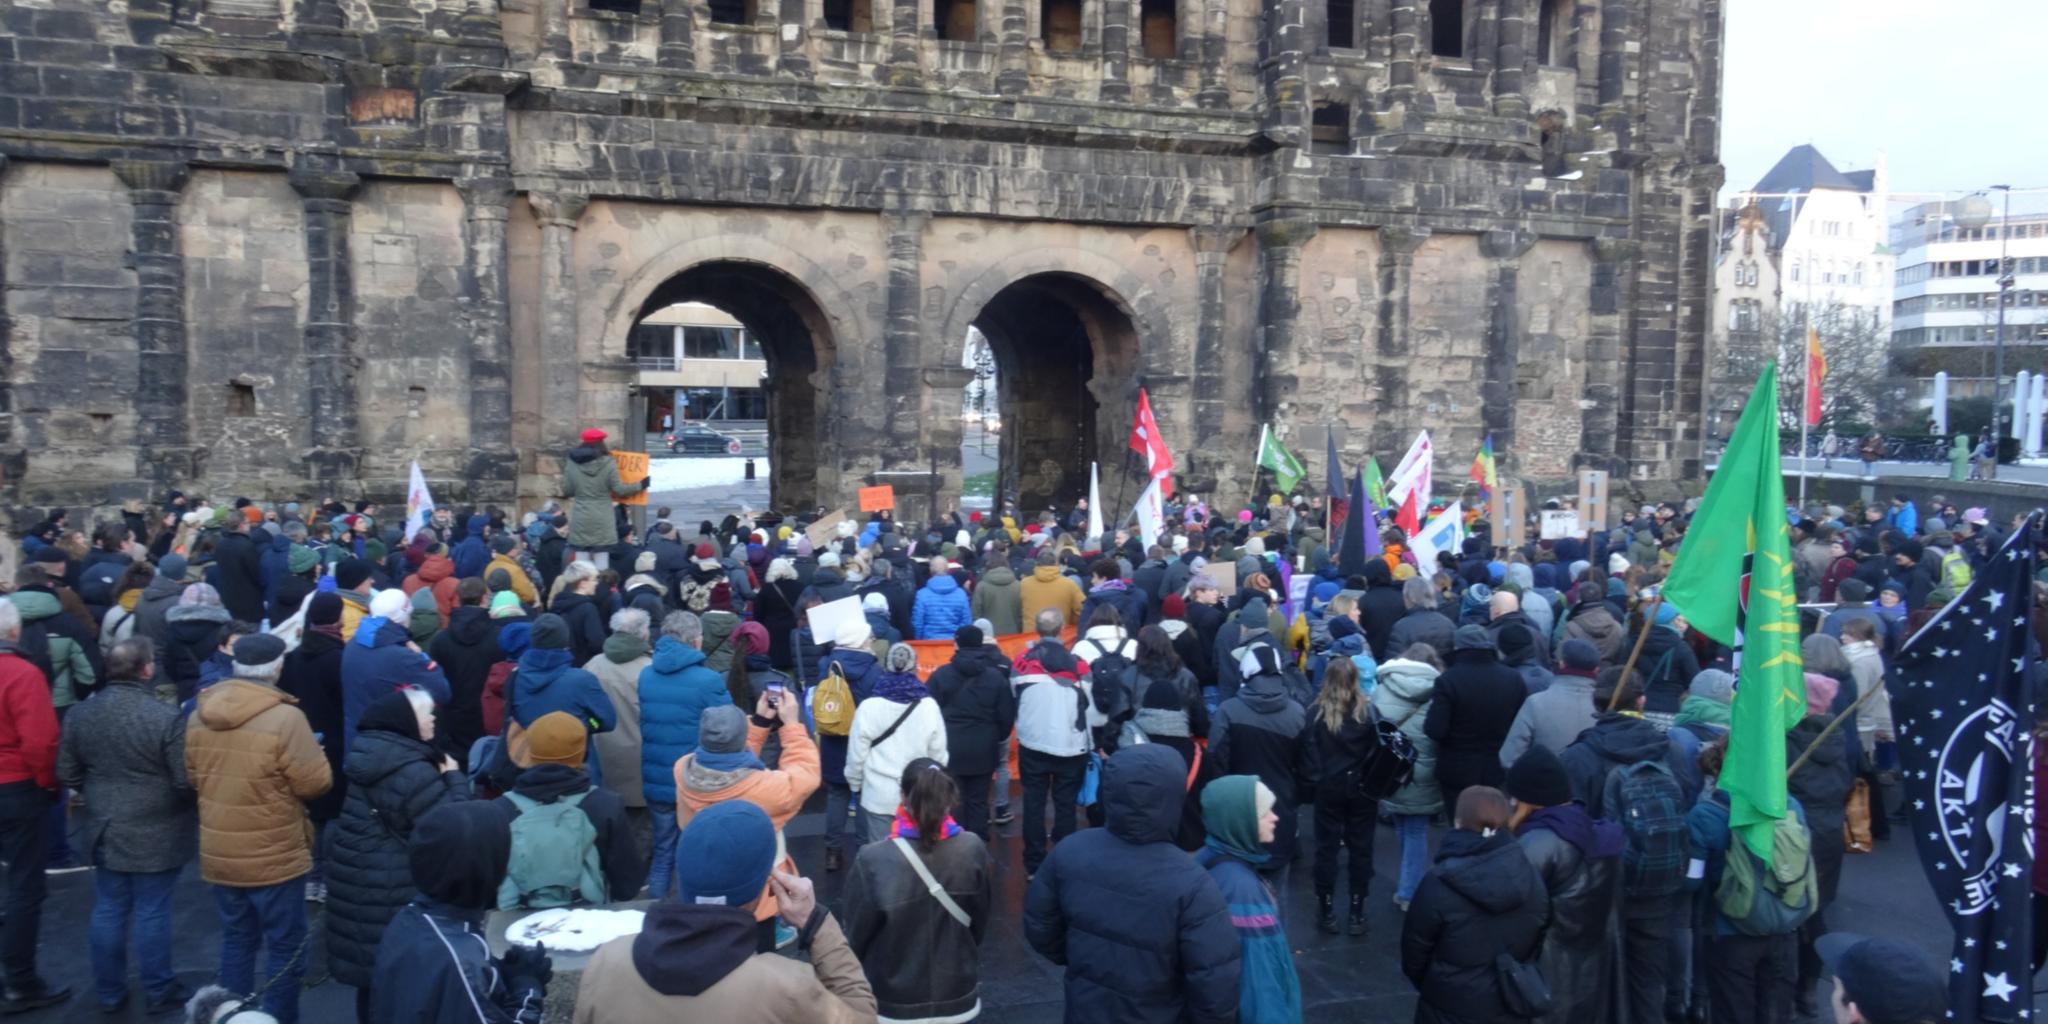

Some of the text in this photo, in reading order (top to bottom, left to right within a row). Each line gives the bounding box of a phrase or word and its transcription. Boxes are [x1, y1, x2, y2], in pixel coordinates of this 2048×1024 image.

[1987, 707, 2016, 750] FA
[1941, 769, 1972, 855] AKT
[1964, 867, 1999, 906] HE
